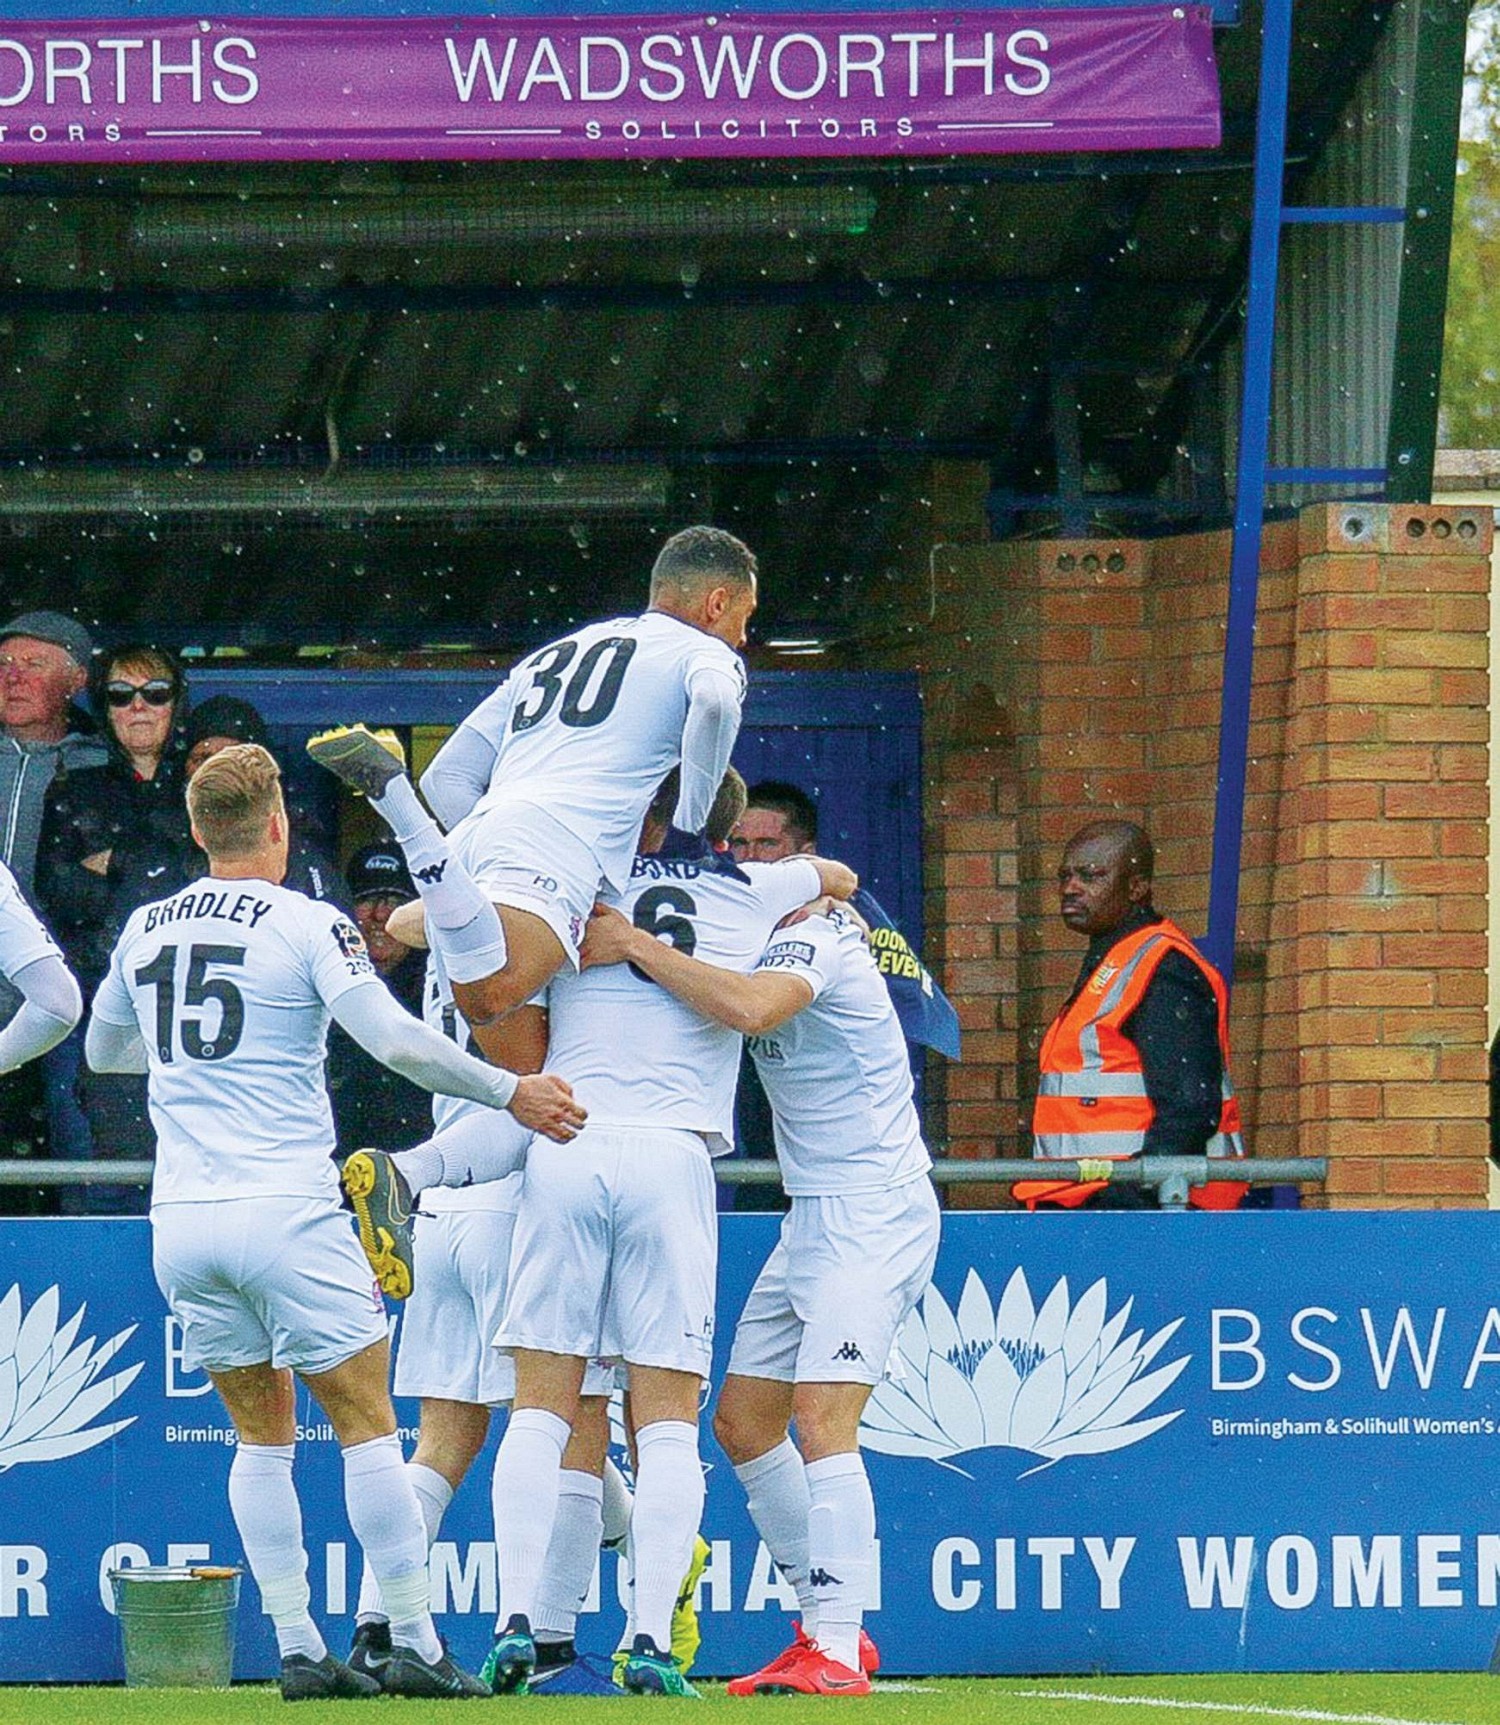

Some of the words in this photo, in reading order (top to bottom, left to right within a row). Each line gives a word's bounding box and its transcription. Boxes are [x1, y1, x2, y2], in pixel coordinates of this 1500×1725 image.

[444, 30, 1052, 101] WADSWORTHS
[585, 117, 914, 139] SOLICITORS
[512, 636, 637, 734] 30
[144, 892, 272, 934] BRADLEY
[628, 885, 697, 984] 6
[134, 943, 248, 1065] 15
[165, 1424, 240, 1444] Birming
[295, 1424, 340, 1442] Solih
[1211, 1419, 1322, 1440] Birmingham
[1325, 1420, 1339, 1435] &
[1342, 1418, 1409, 1435] Solihull
[1413, 1417, 1495, 1435] Women's
[931, 1536, 1137, 1612] CITY
